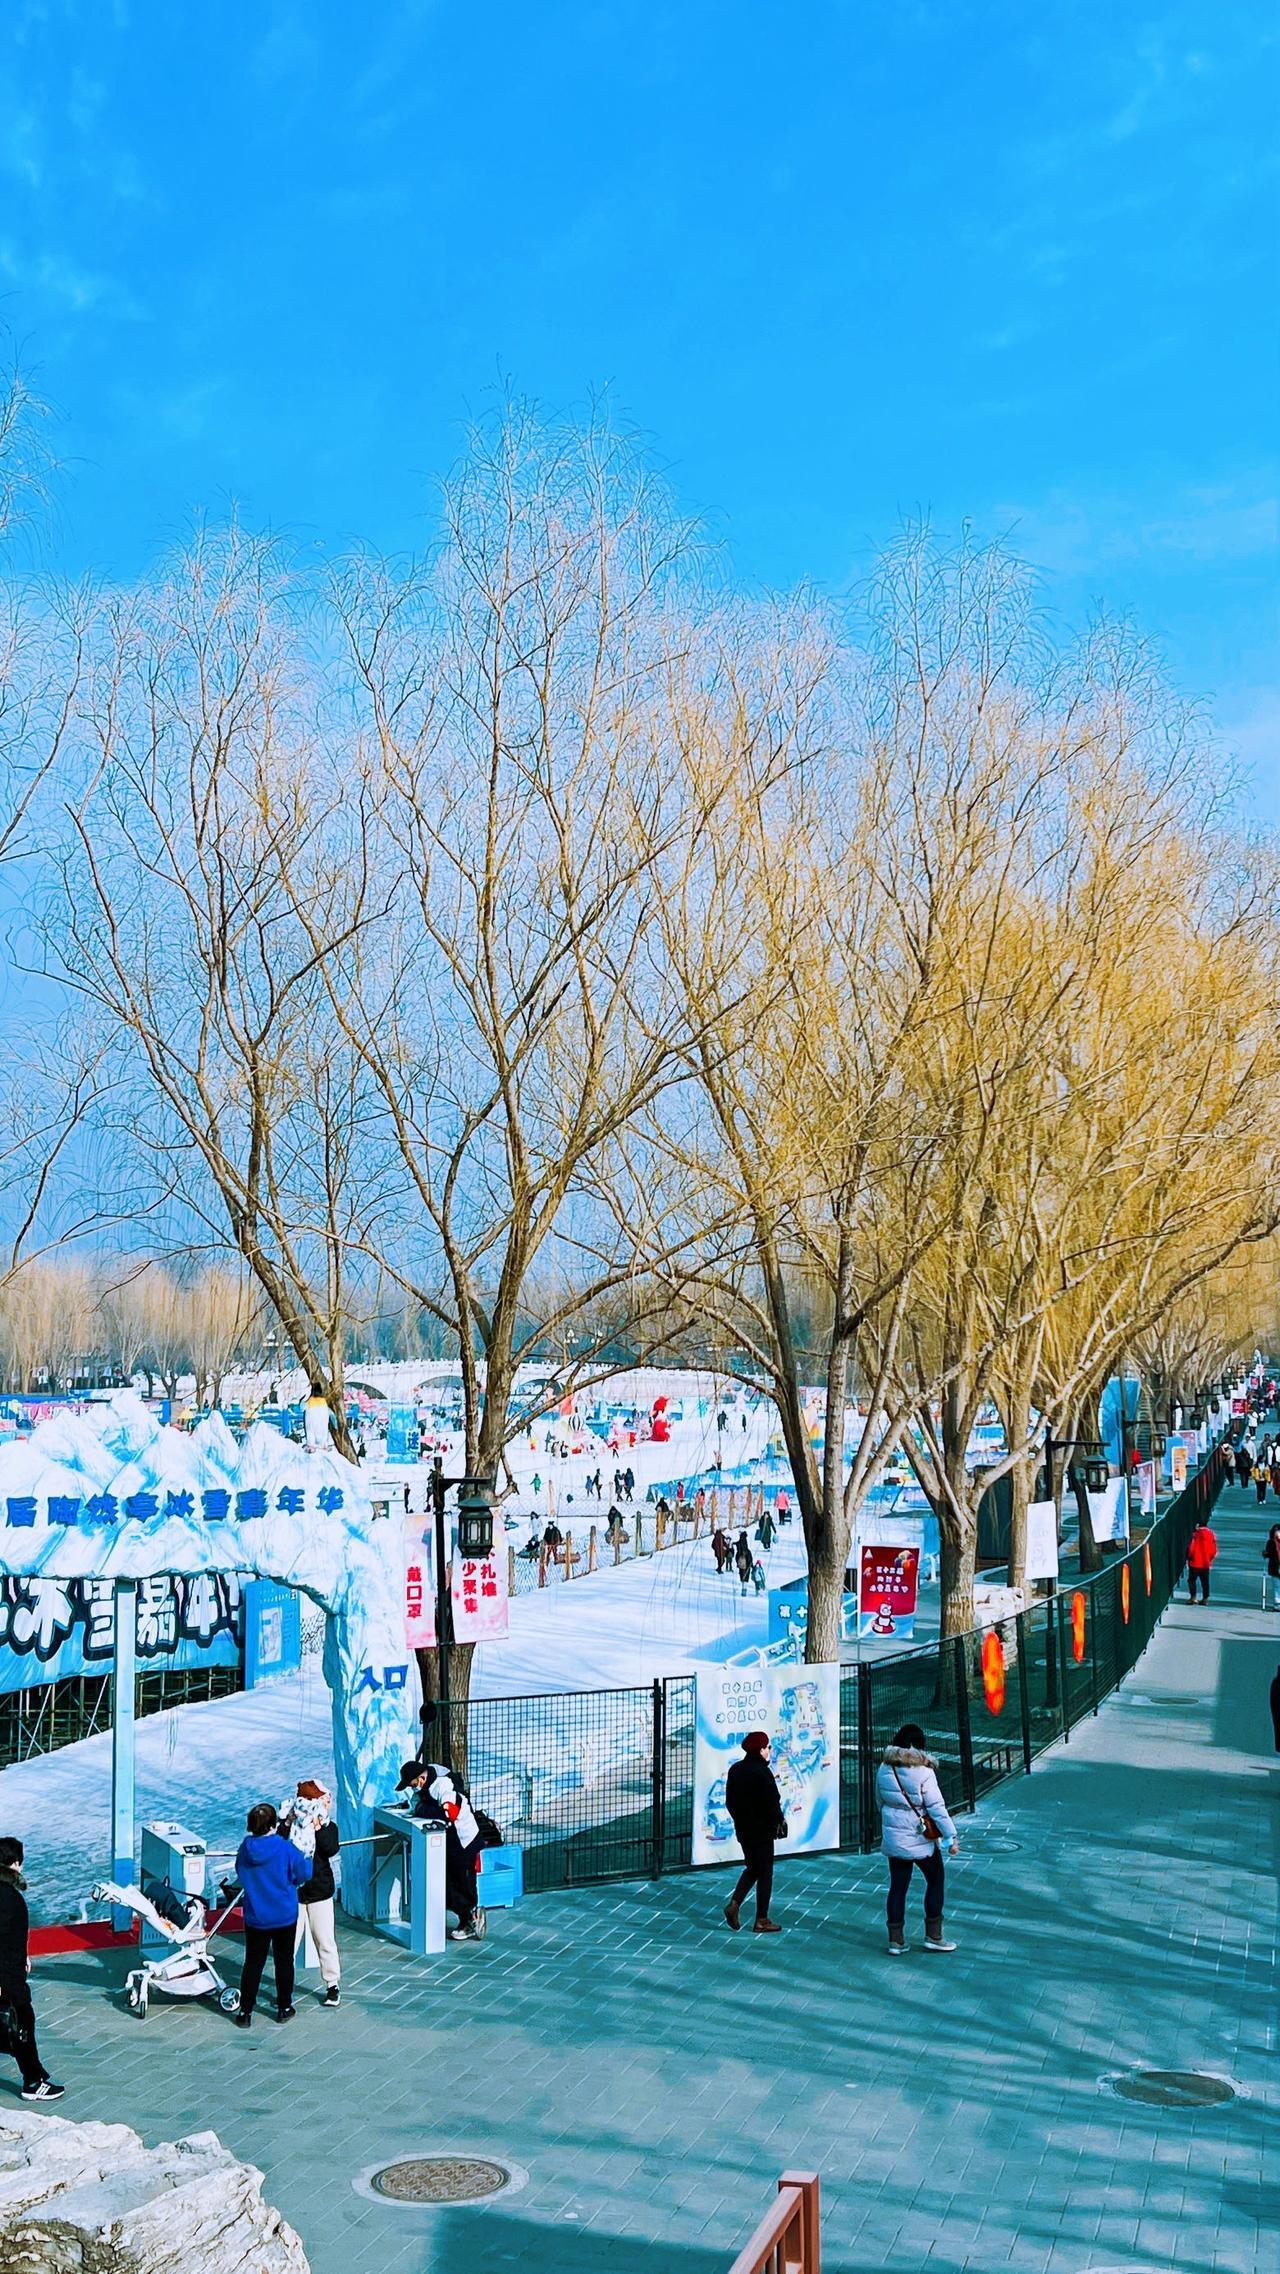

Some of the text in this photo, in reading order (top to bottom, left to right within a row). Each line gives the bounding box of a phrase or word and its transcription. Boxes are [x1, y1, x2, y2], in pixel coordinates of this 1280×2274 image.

[5, 1485, 345, 1528] 届陶然亭冰雪嘉年华
[407, 1566, 423, 1618] 戴口罩
[462, 1561, 478, 1613] 少聚集
[481, 1552, 497, 1598] 扎堆
[359, 1664, 409, 1692] 入口
